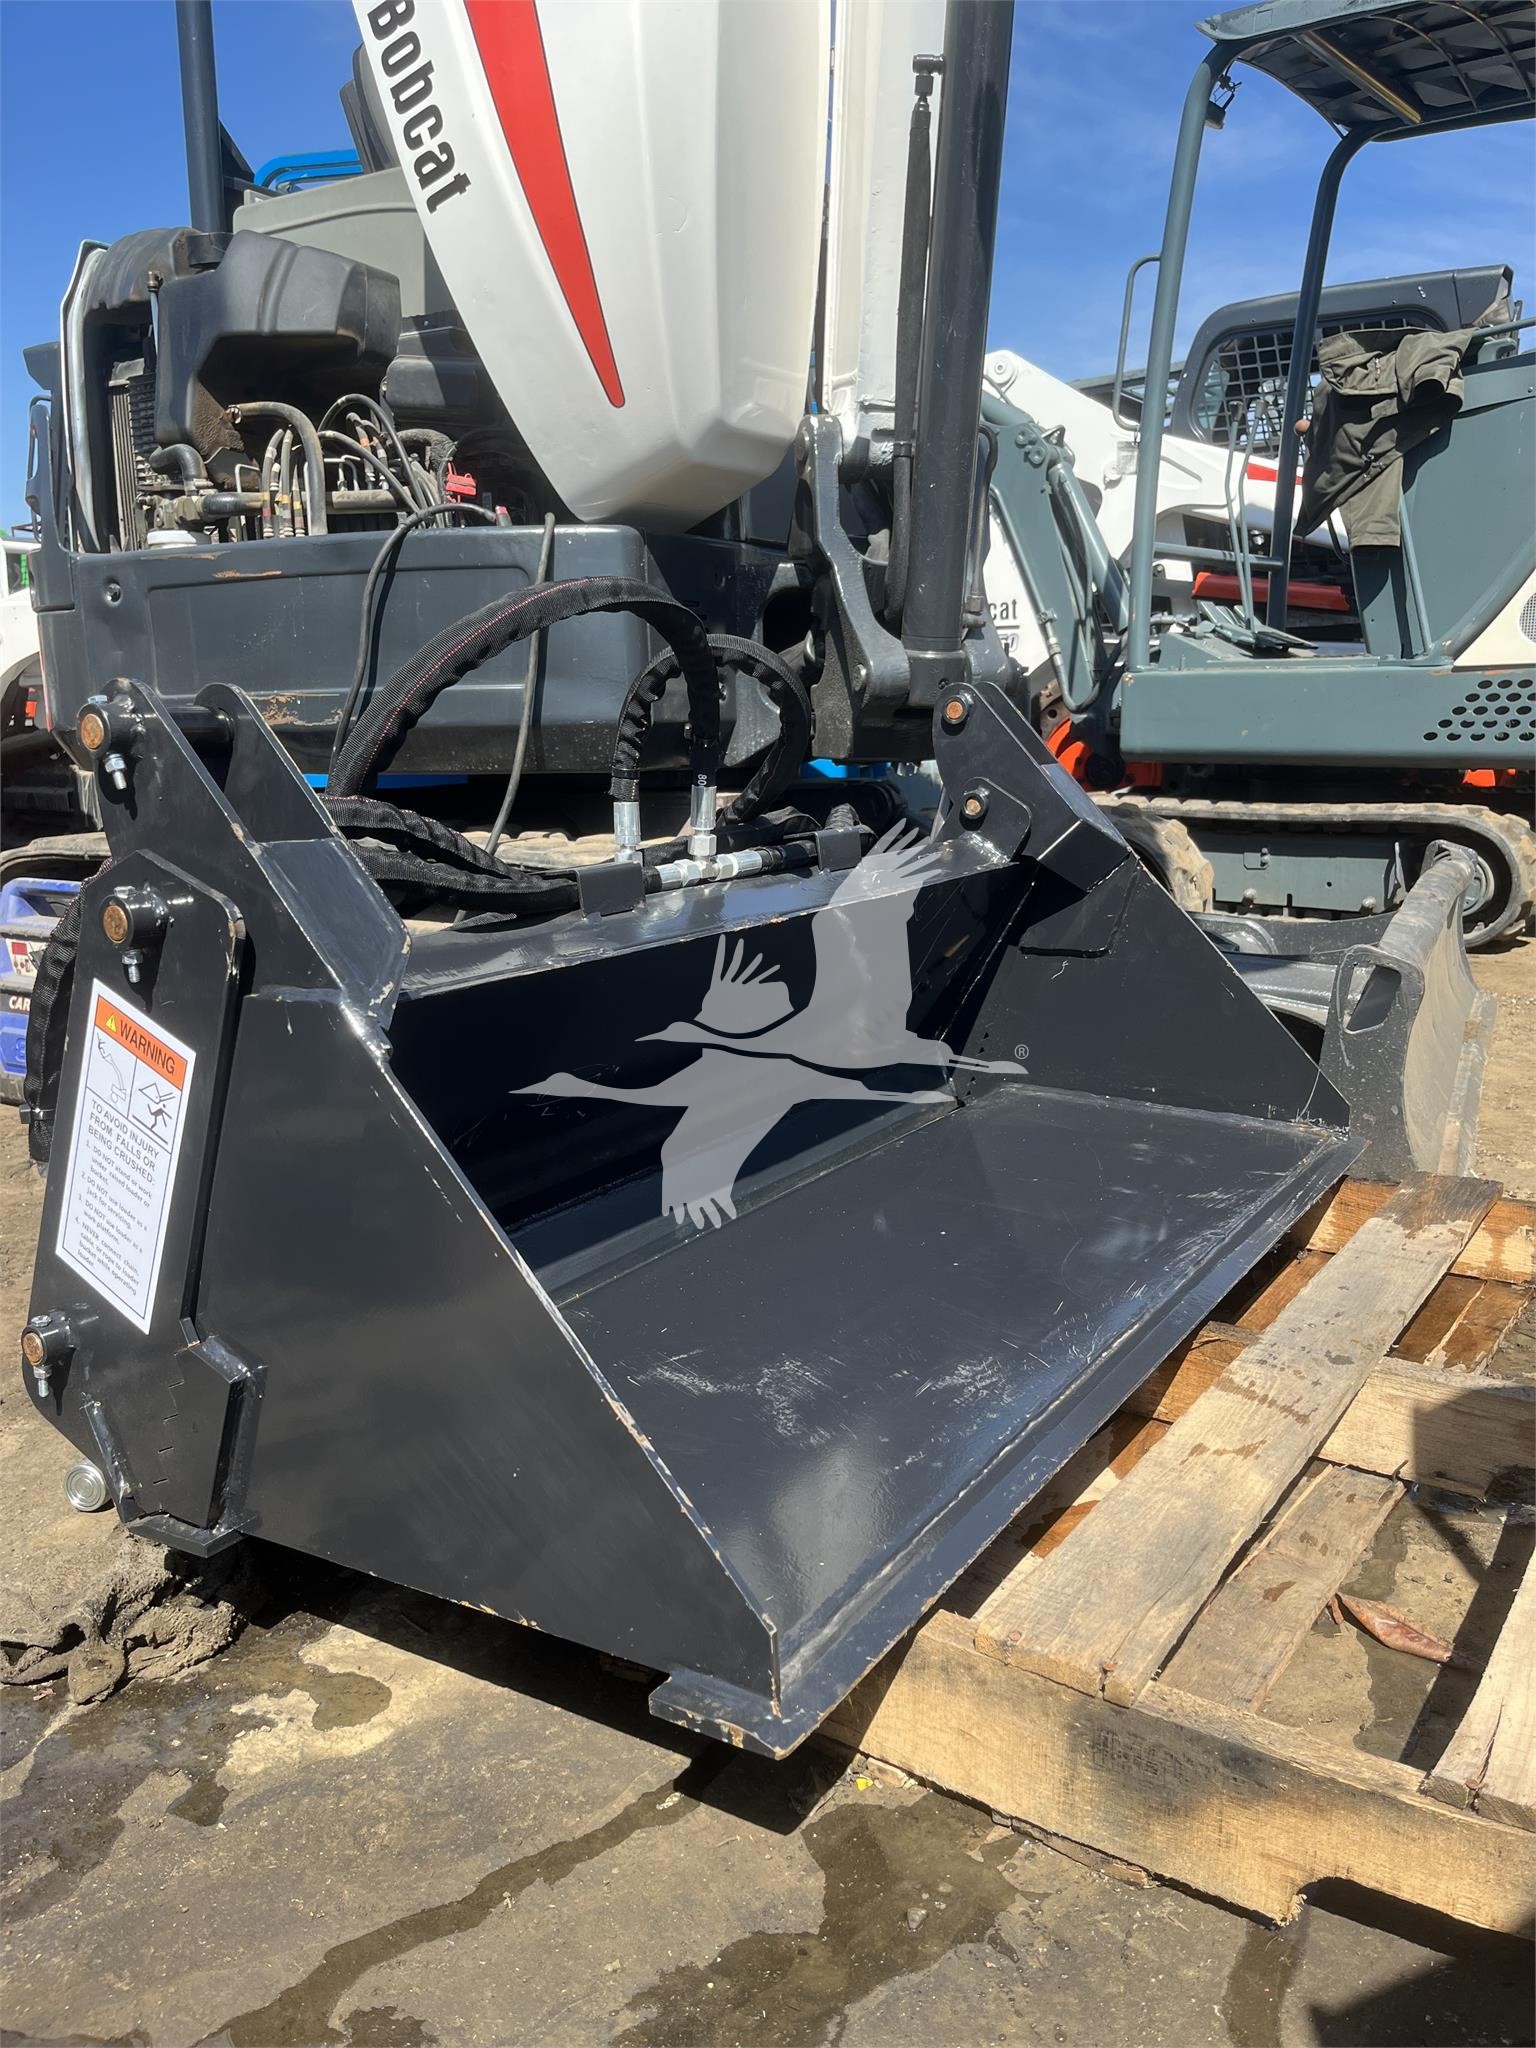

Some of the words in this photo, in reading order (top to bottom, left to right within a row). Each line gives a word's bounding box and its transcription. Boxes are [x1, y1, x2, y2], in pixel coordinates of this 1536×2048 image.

[367, 0, 472, 215] Bobcat
[118, 1019, 176, 1076] WARNING
[87, 1123, 112, 1151] BEING
[89, 1111, 112, 1137] FROM
[115, 1132, 141, 1160] FALLS
[142, 1153, 156, 1172] OR
[91, 1098, 103, 1115] TO
[103, 1108, 128, 1135] AVOID
[129, 1129, 159, 1160] INJURY
[93, 1145, 101, 1157] DO
[102, 1152, 114, 1168] NOT
[86, 1174, 95, 1187] DO
[95, 1182, 108, 1198] NOT
[84, 1198, 93, 1211] DO
[93, 1205, 106, 1221] NOT
[81, 1221, 99, 1241] NEVER
